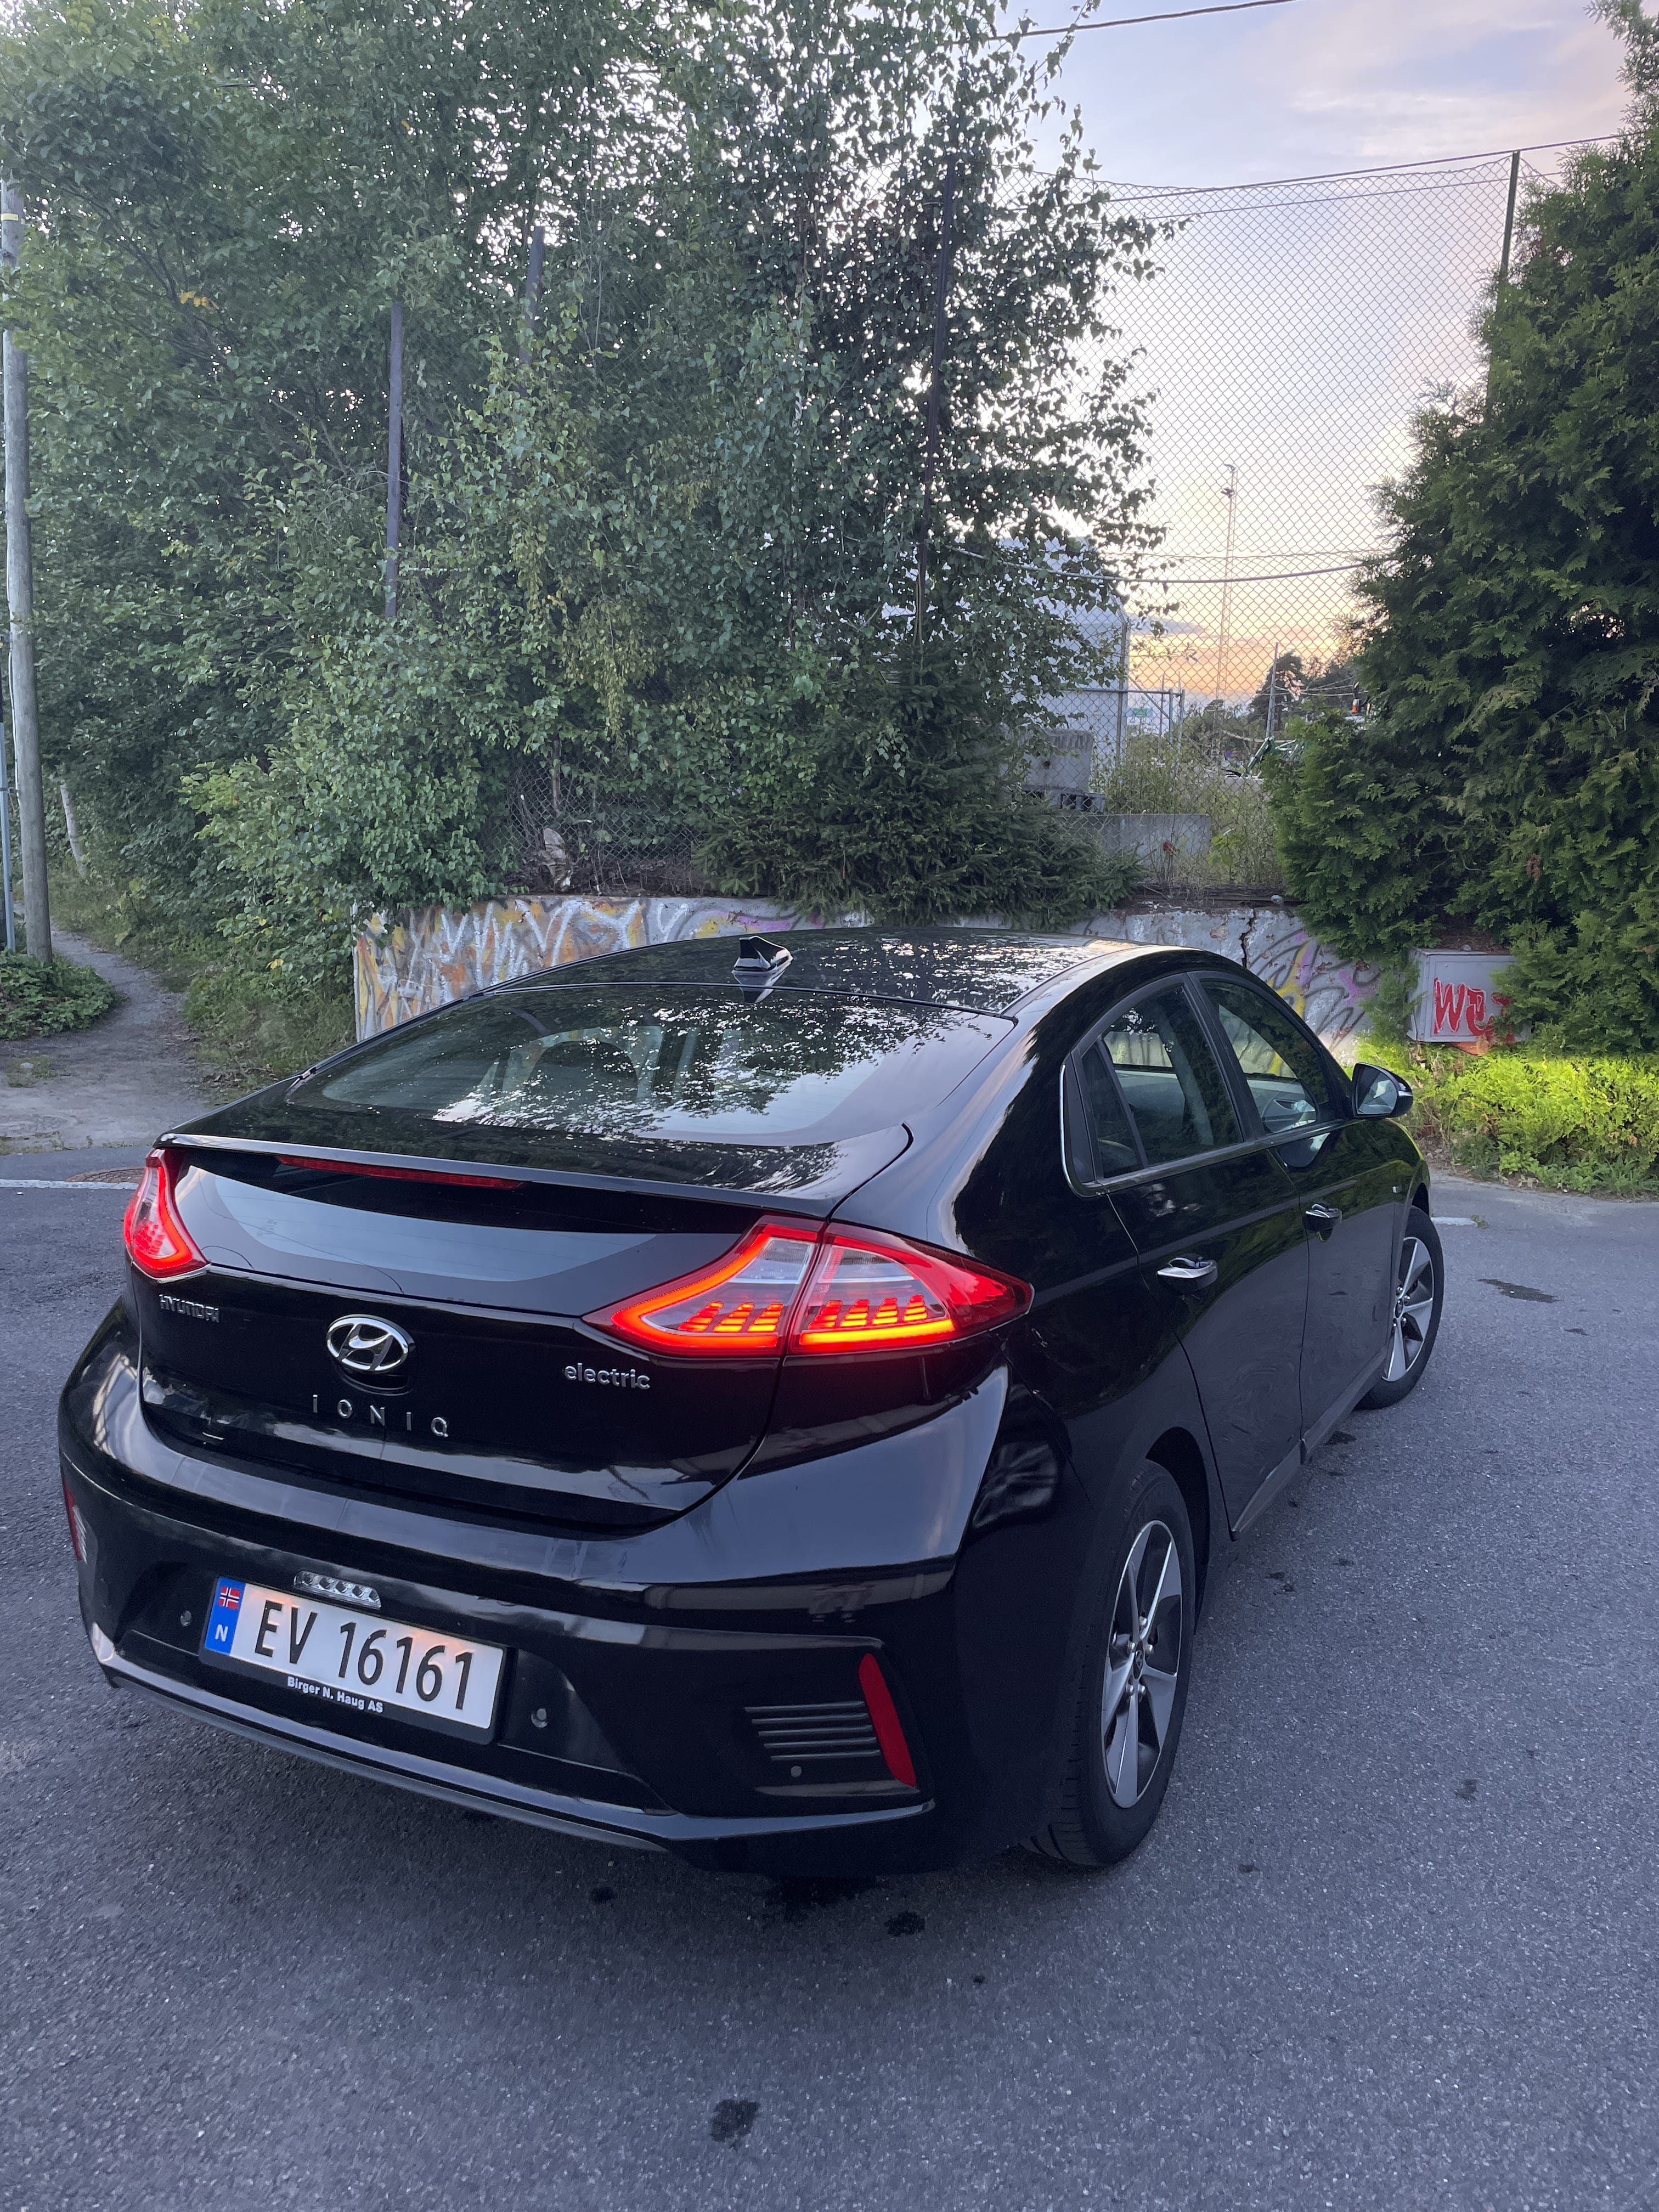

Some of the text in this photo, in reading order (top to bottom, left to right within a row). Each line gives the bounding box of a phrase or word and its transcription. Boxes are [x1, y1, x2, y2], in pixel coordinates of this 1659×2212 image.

[159, 1294, 219, 1323] HYUNDAI
[564, 1362, 650, 1390] electric
[312, 1394, 449, 1437] IONIQ
[215, 1624, 228, 1642] N
[255, 1599, 473, 1710] EV 16161
[287, 1676, 383, 1713] Birger N. Haug AS
